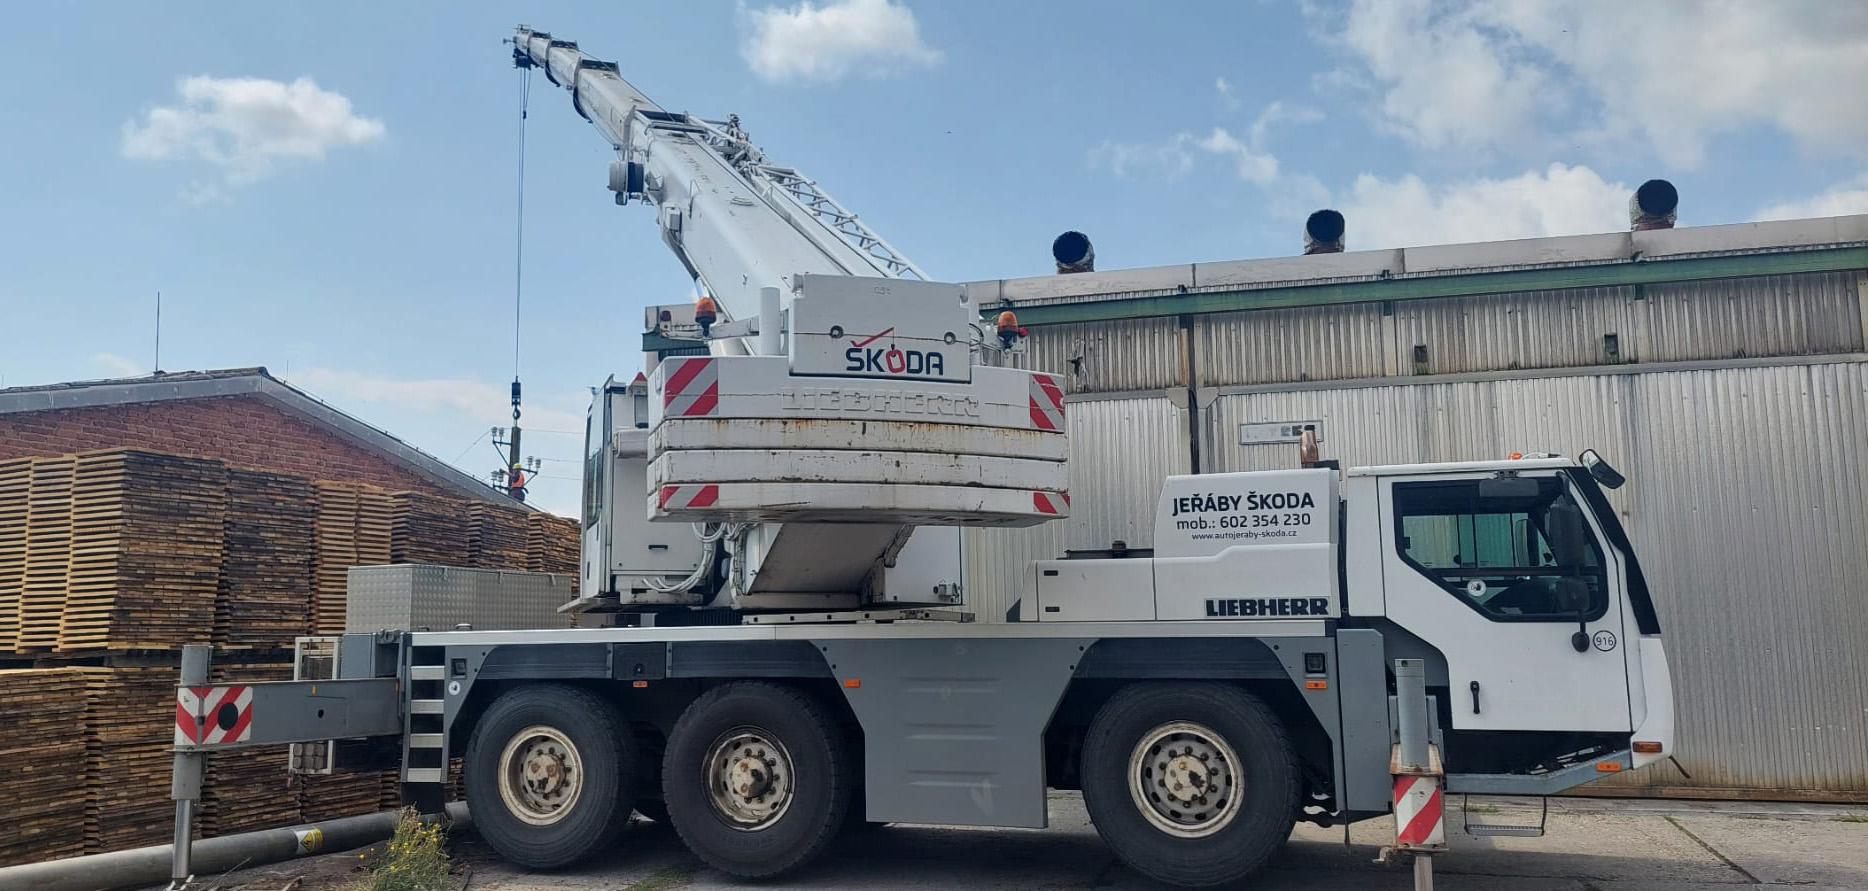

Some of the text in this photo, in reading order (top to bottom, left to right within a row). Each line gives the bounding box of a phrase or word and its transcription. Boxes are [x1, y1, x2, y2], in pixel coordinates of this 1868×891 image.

[782, 387, 980, 418] LIEBHERR
[1172, 490, 1315, 516] JEŘÁBY ŠKODA
[1176, 512, 1311, 530] mob.: 602 354 230
[1191, 529, 1298, 541] www.autojeraby-skoda.cz
[1205, 597, 1329, 617] LIEBHERR
[1596, 636, 1614, 646] 916
